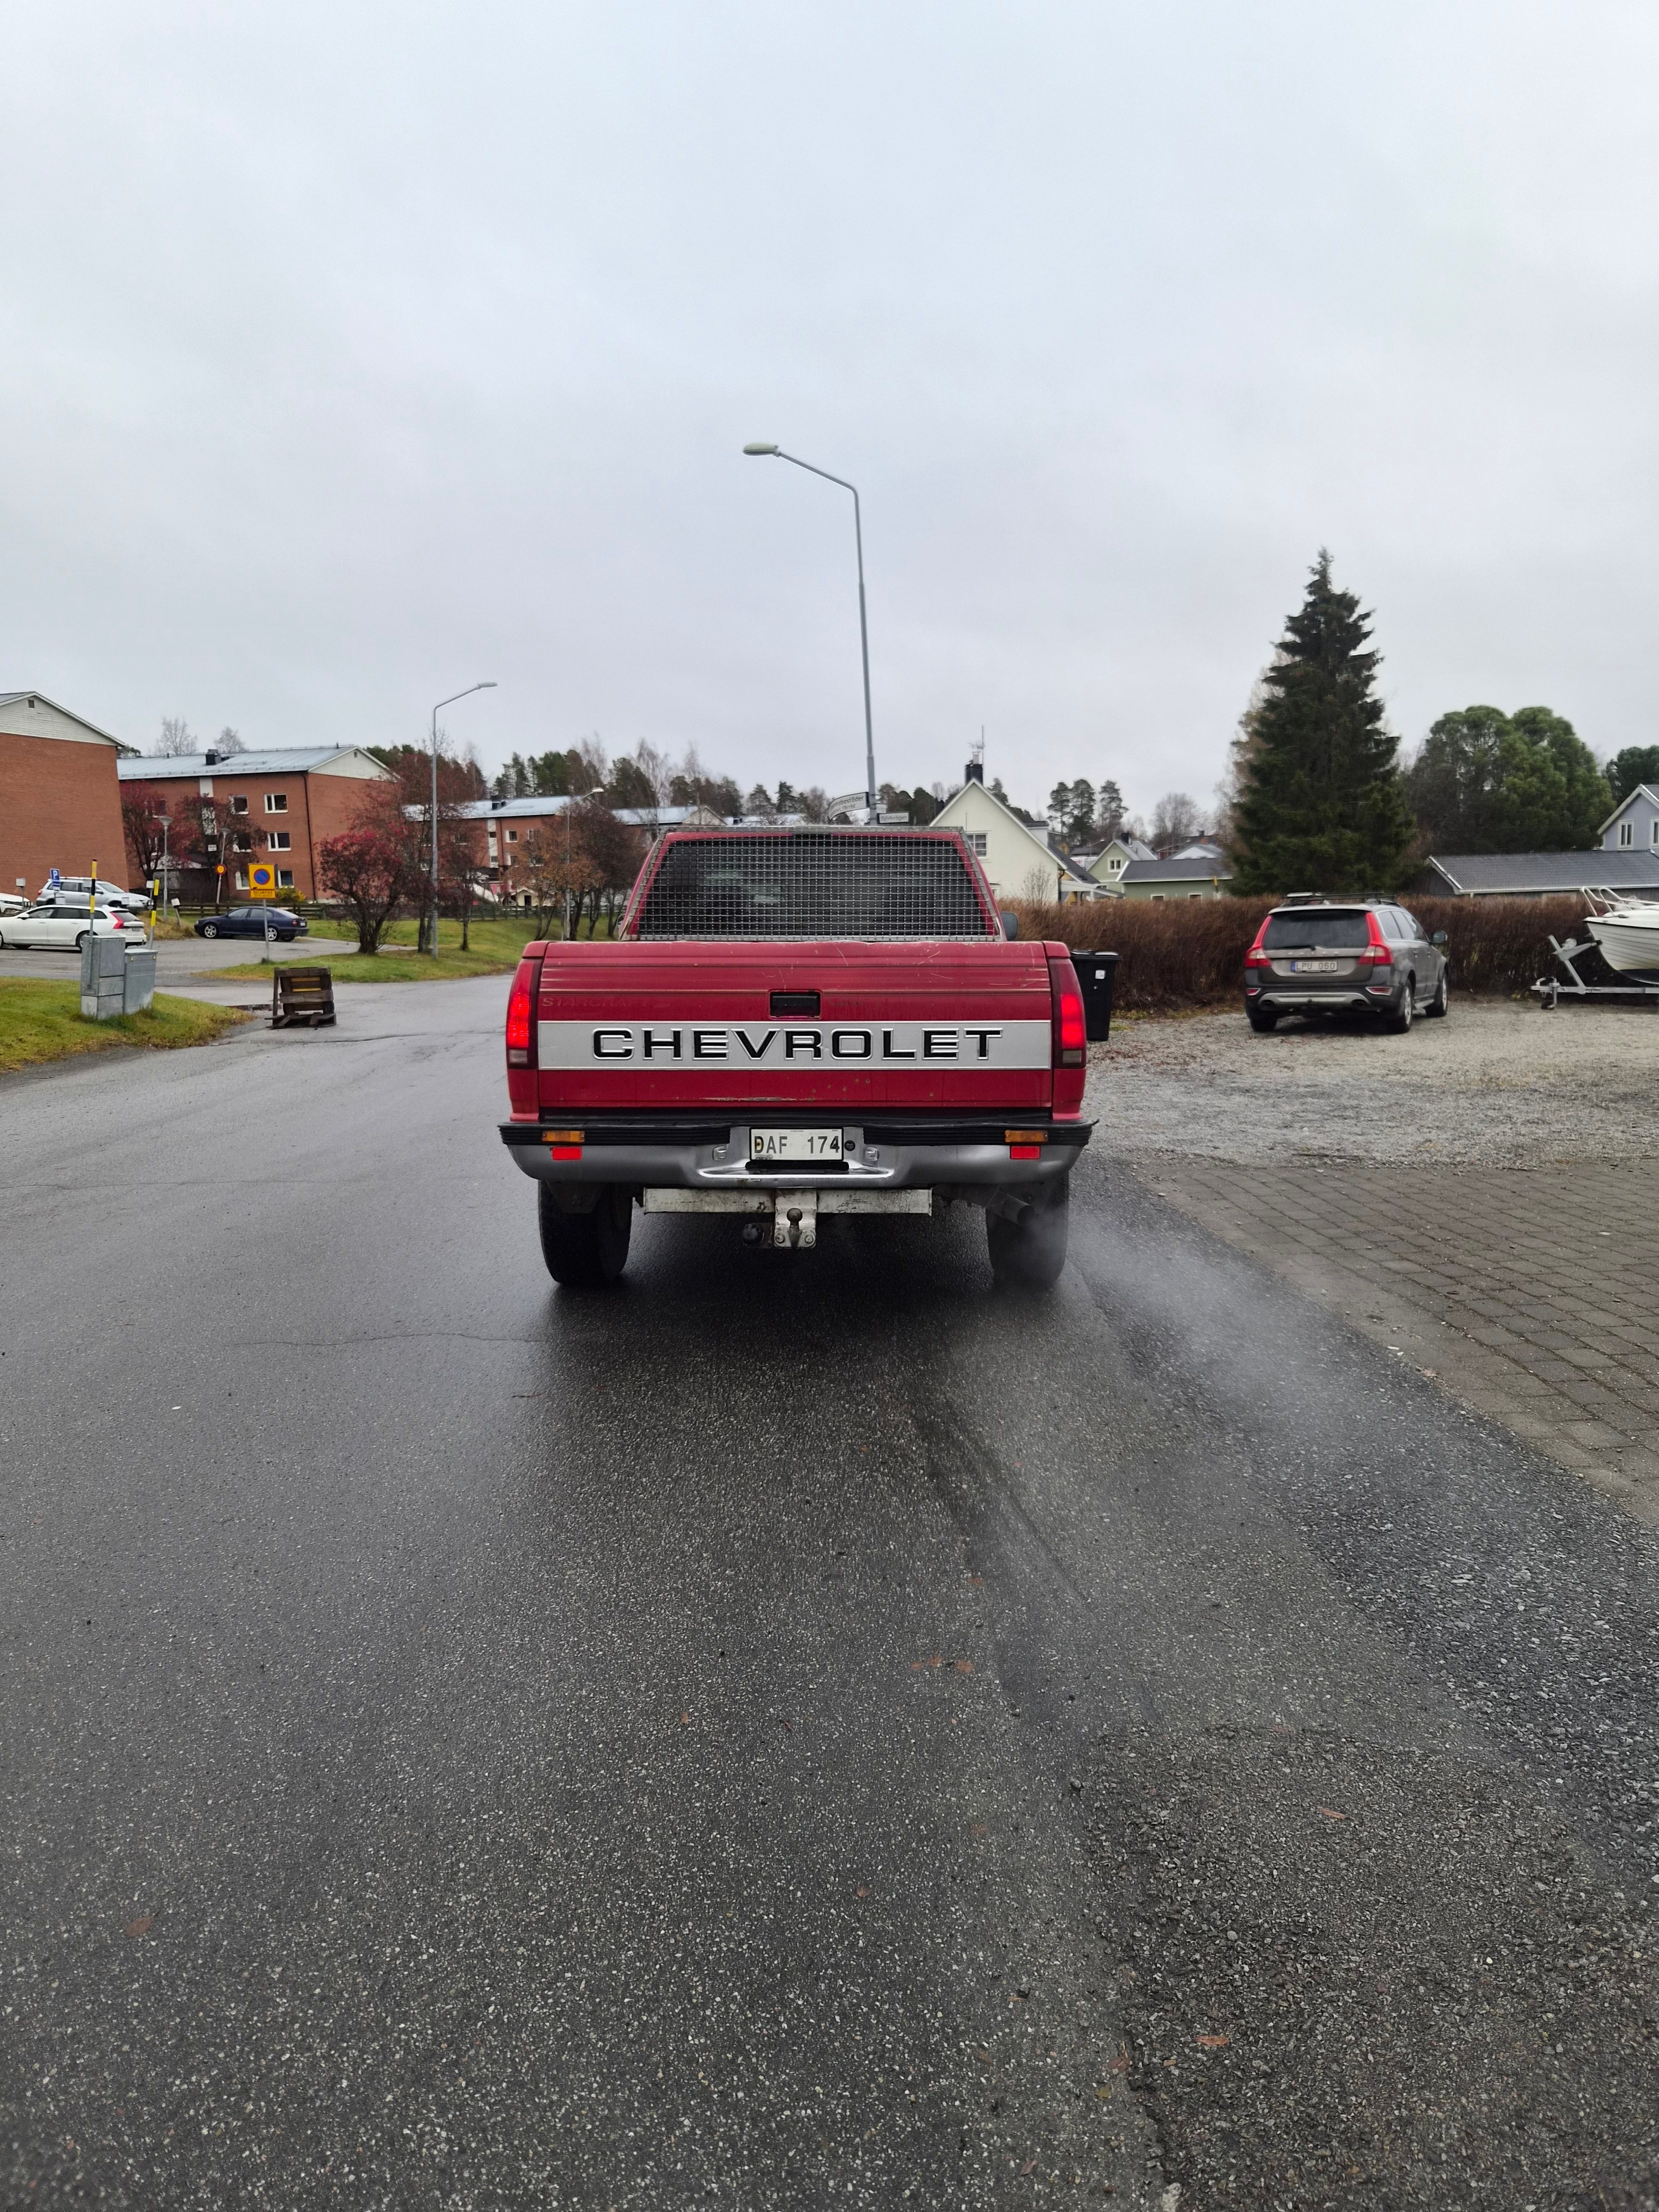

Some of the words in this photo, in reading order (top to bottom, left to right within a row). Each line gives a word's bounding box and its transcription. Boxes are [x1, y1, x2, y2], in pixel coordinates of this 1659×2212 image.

[53, 870, 58, 879] P
[592, 1028, 1003, 1061] CHEVROLET
[754, 1135, 787, 1154] DAF
[807, 1135, 840, 1154] 174
